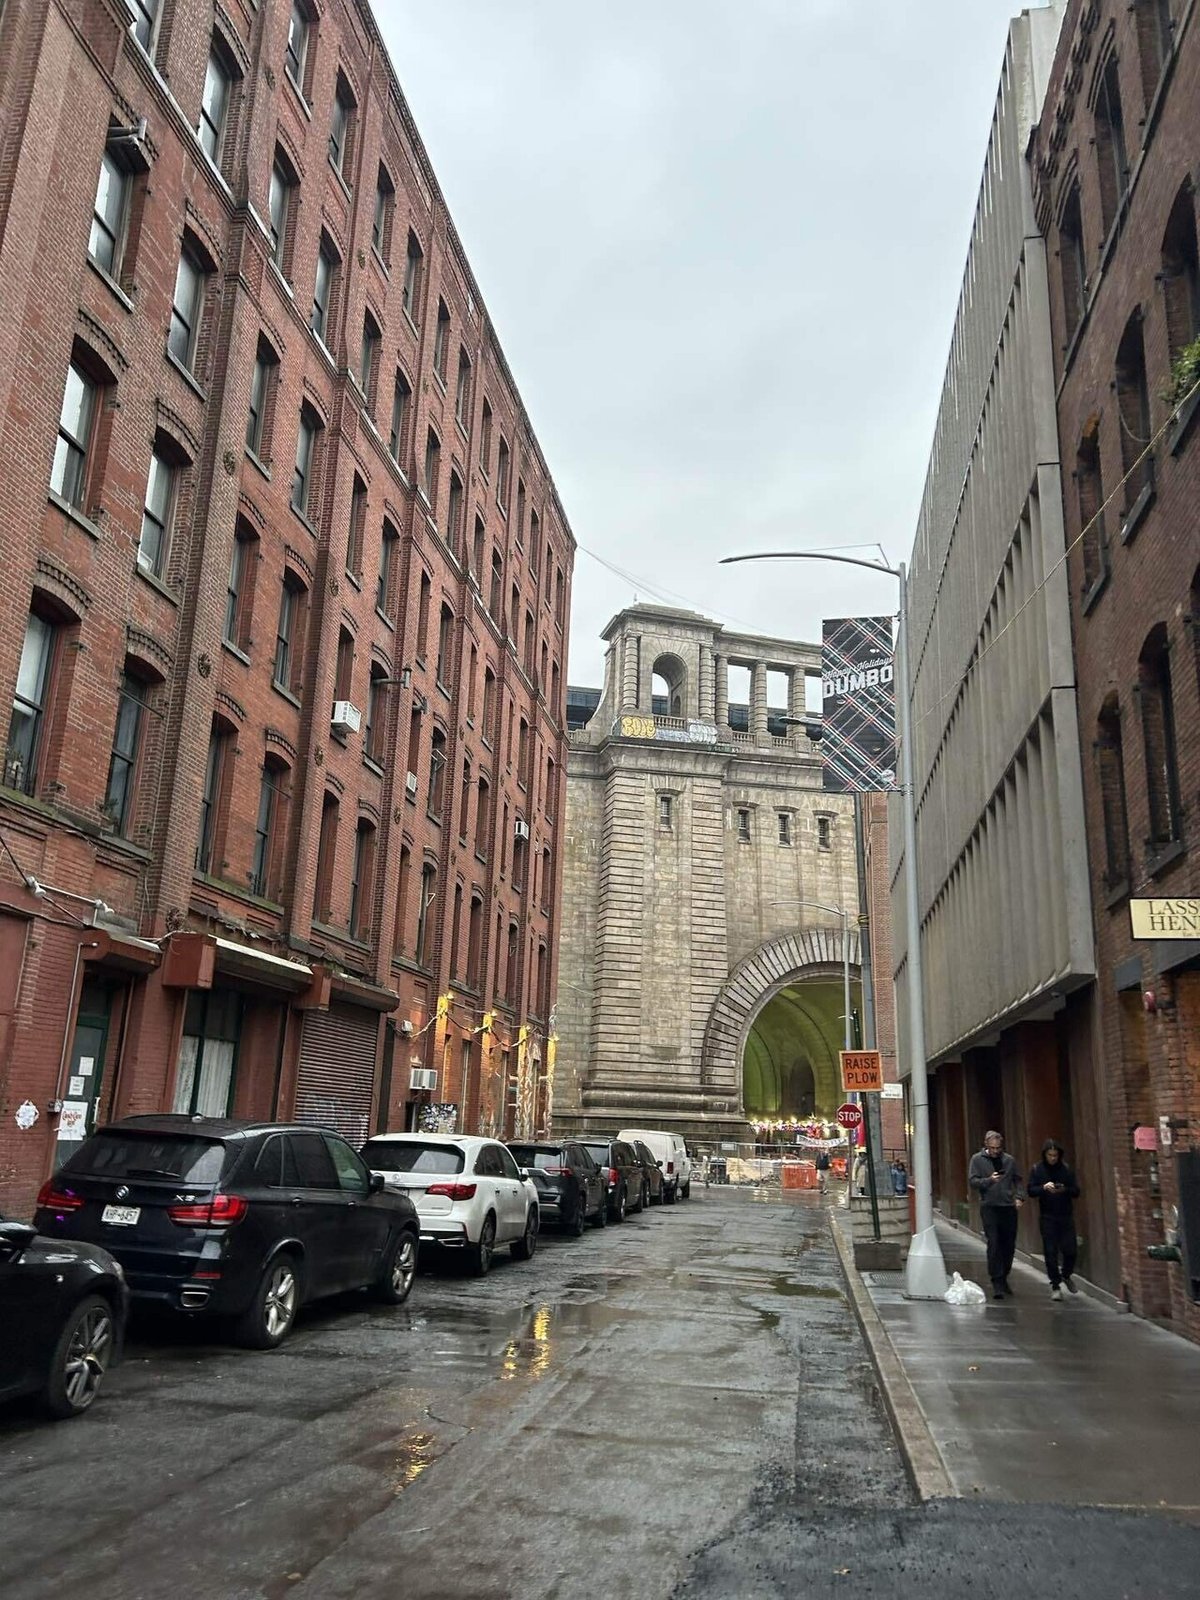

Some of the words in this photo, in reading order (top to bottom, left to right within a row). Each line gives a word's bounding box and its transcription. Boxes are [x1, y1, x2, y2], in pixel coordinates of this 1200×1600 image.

[822, 664, 893, 699] DUMBO
[845, 1058, 877, 1070] RAISE
[847, 1072, 878, 1084] PLOW
[838, 1111, 861, 1122] STOP
